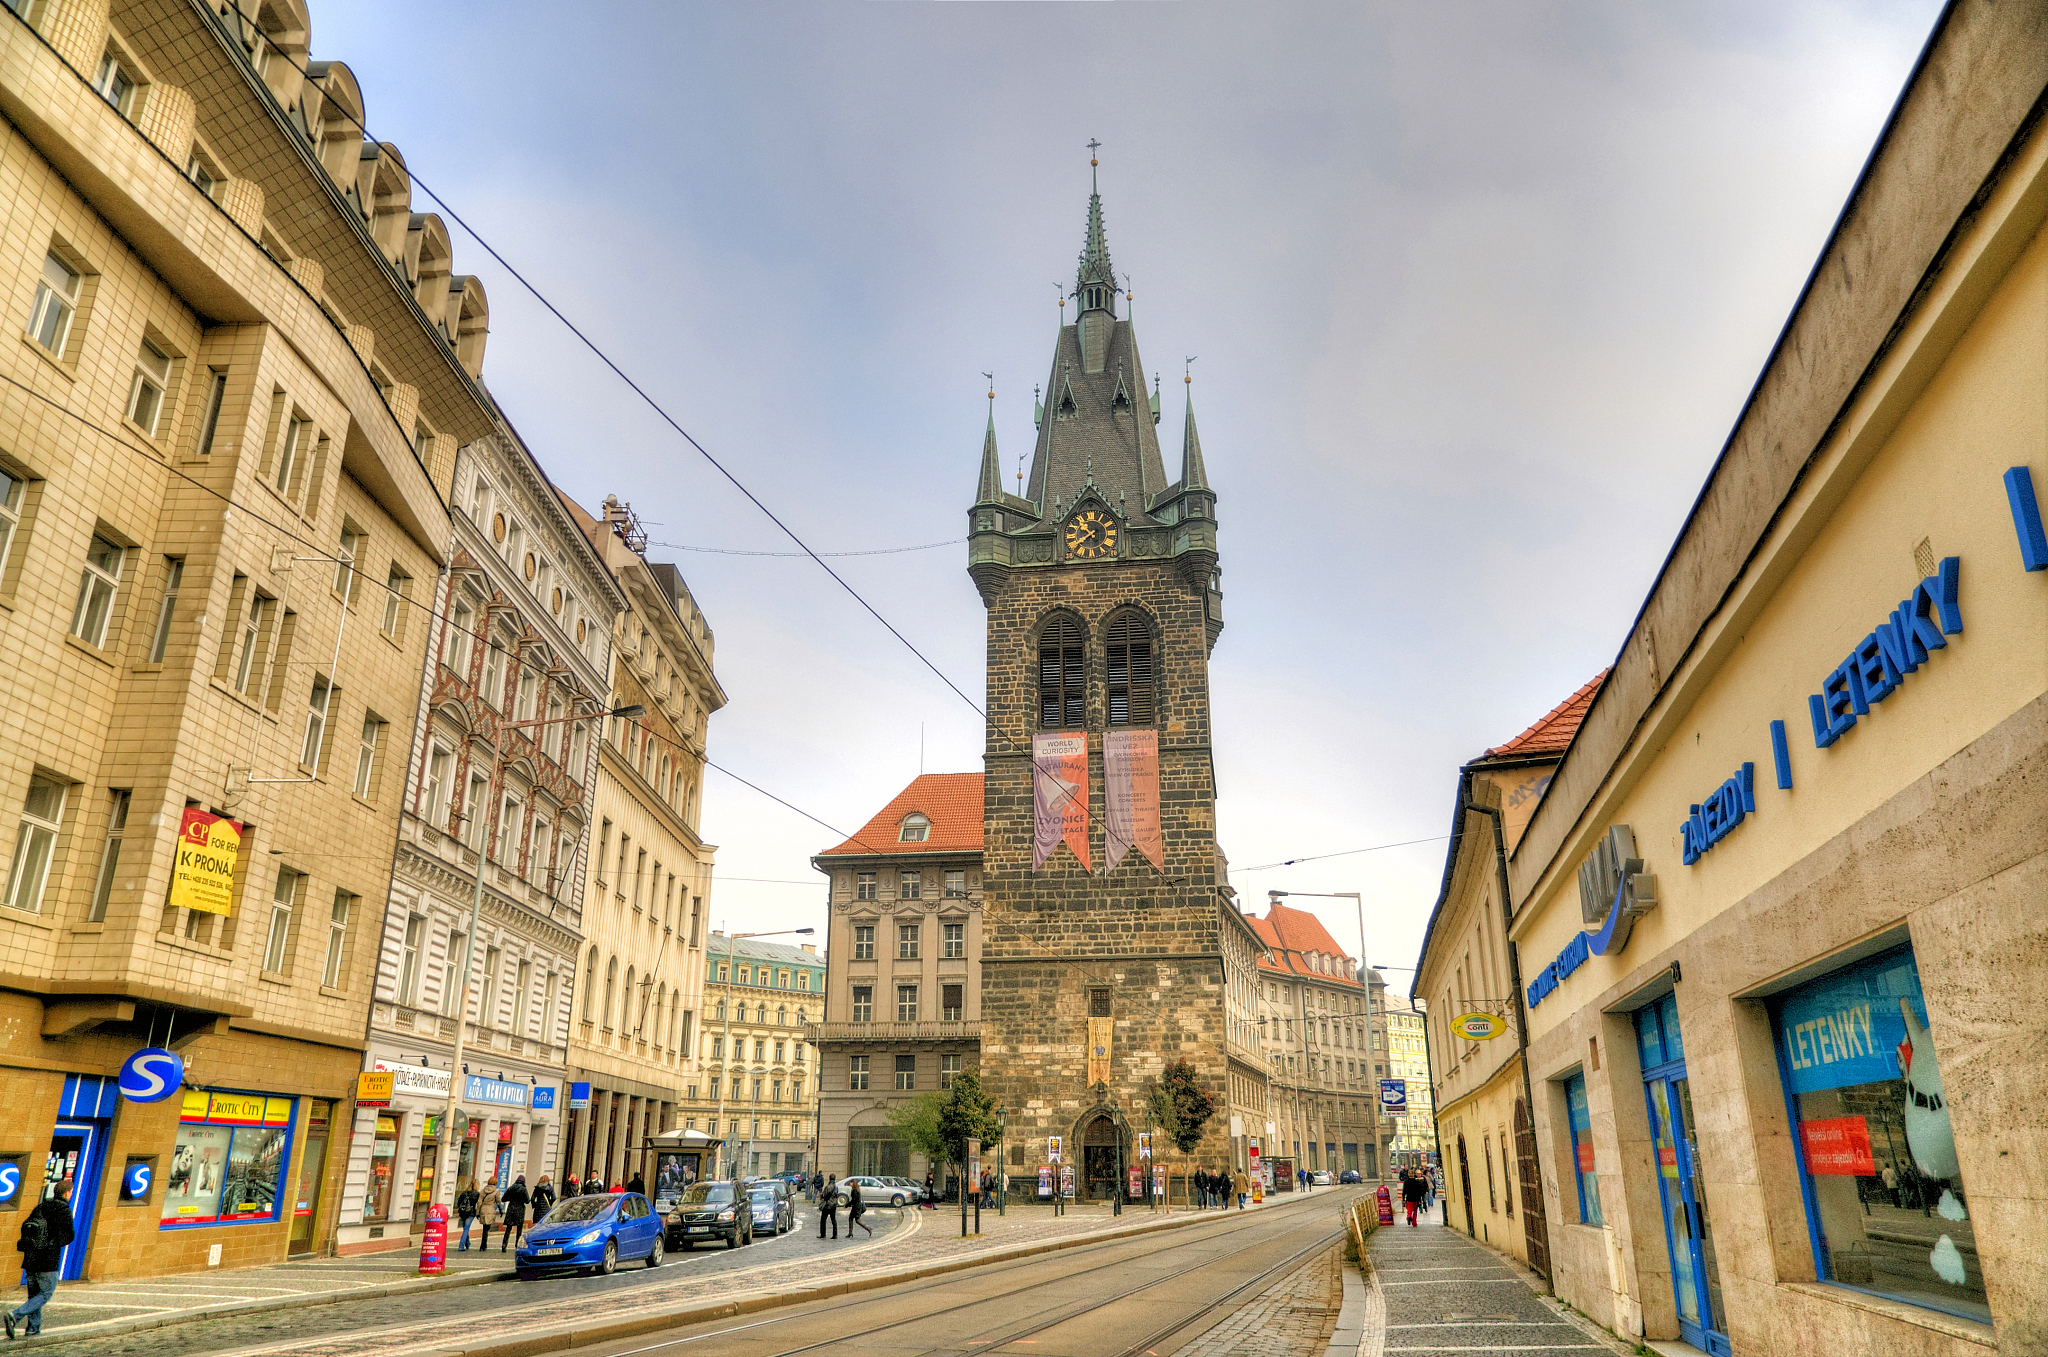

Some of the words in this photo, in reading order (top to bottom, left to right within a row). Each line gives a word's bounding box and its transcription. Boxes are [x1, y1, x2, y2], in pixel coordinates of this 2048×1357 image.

[1680, 762, 1755, 865] ZÁJEZDY
[1808, 556, 1963, 748] LETENKY
[1047, 740, 1073, 748] WORLD
[1042, 746, 1080, 755] CURIOSITY
[1038, 815, 1085, 825] ZVONICE
[1061, 826, 1083, 834] ETAGE
[211, 837, 225, 850] FOR
[181, 851, 193, 867] K
[1467, 1023, 1489, 1031] Conti
[1786, 1003, 1873, 1070] LETENKY
[119, 1054, 174, 1097] S
[364, 1075, 391, 1083] EROTIC
[468, 1086, 483, 1099] AURA
[486, 1082, 503, 1100] OČNÍ
[502, 1086, 524, 1103] OPTIKA
[534, 1094, 552, 1102] AURA
[209, 1099, 240, 1115] EROTIC
[242, 1101, 261, 1116] CITY
